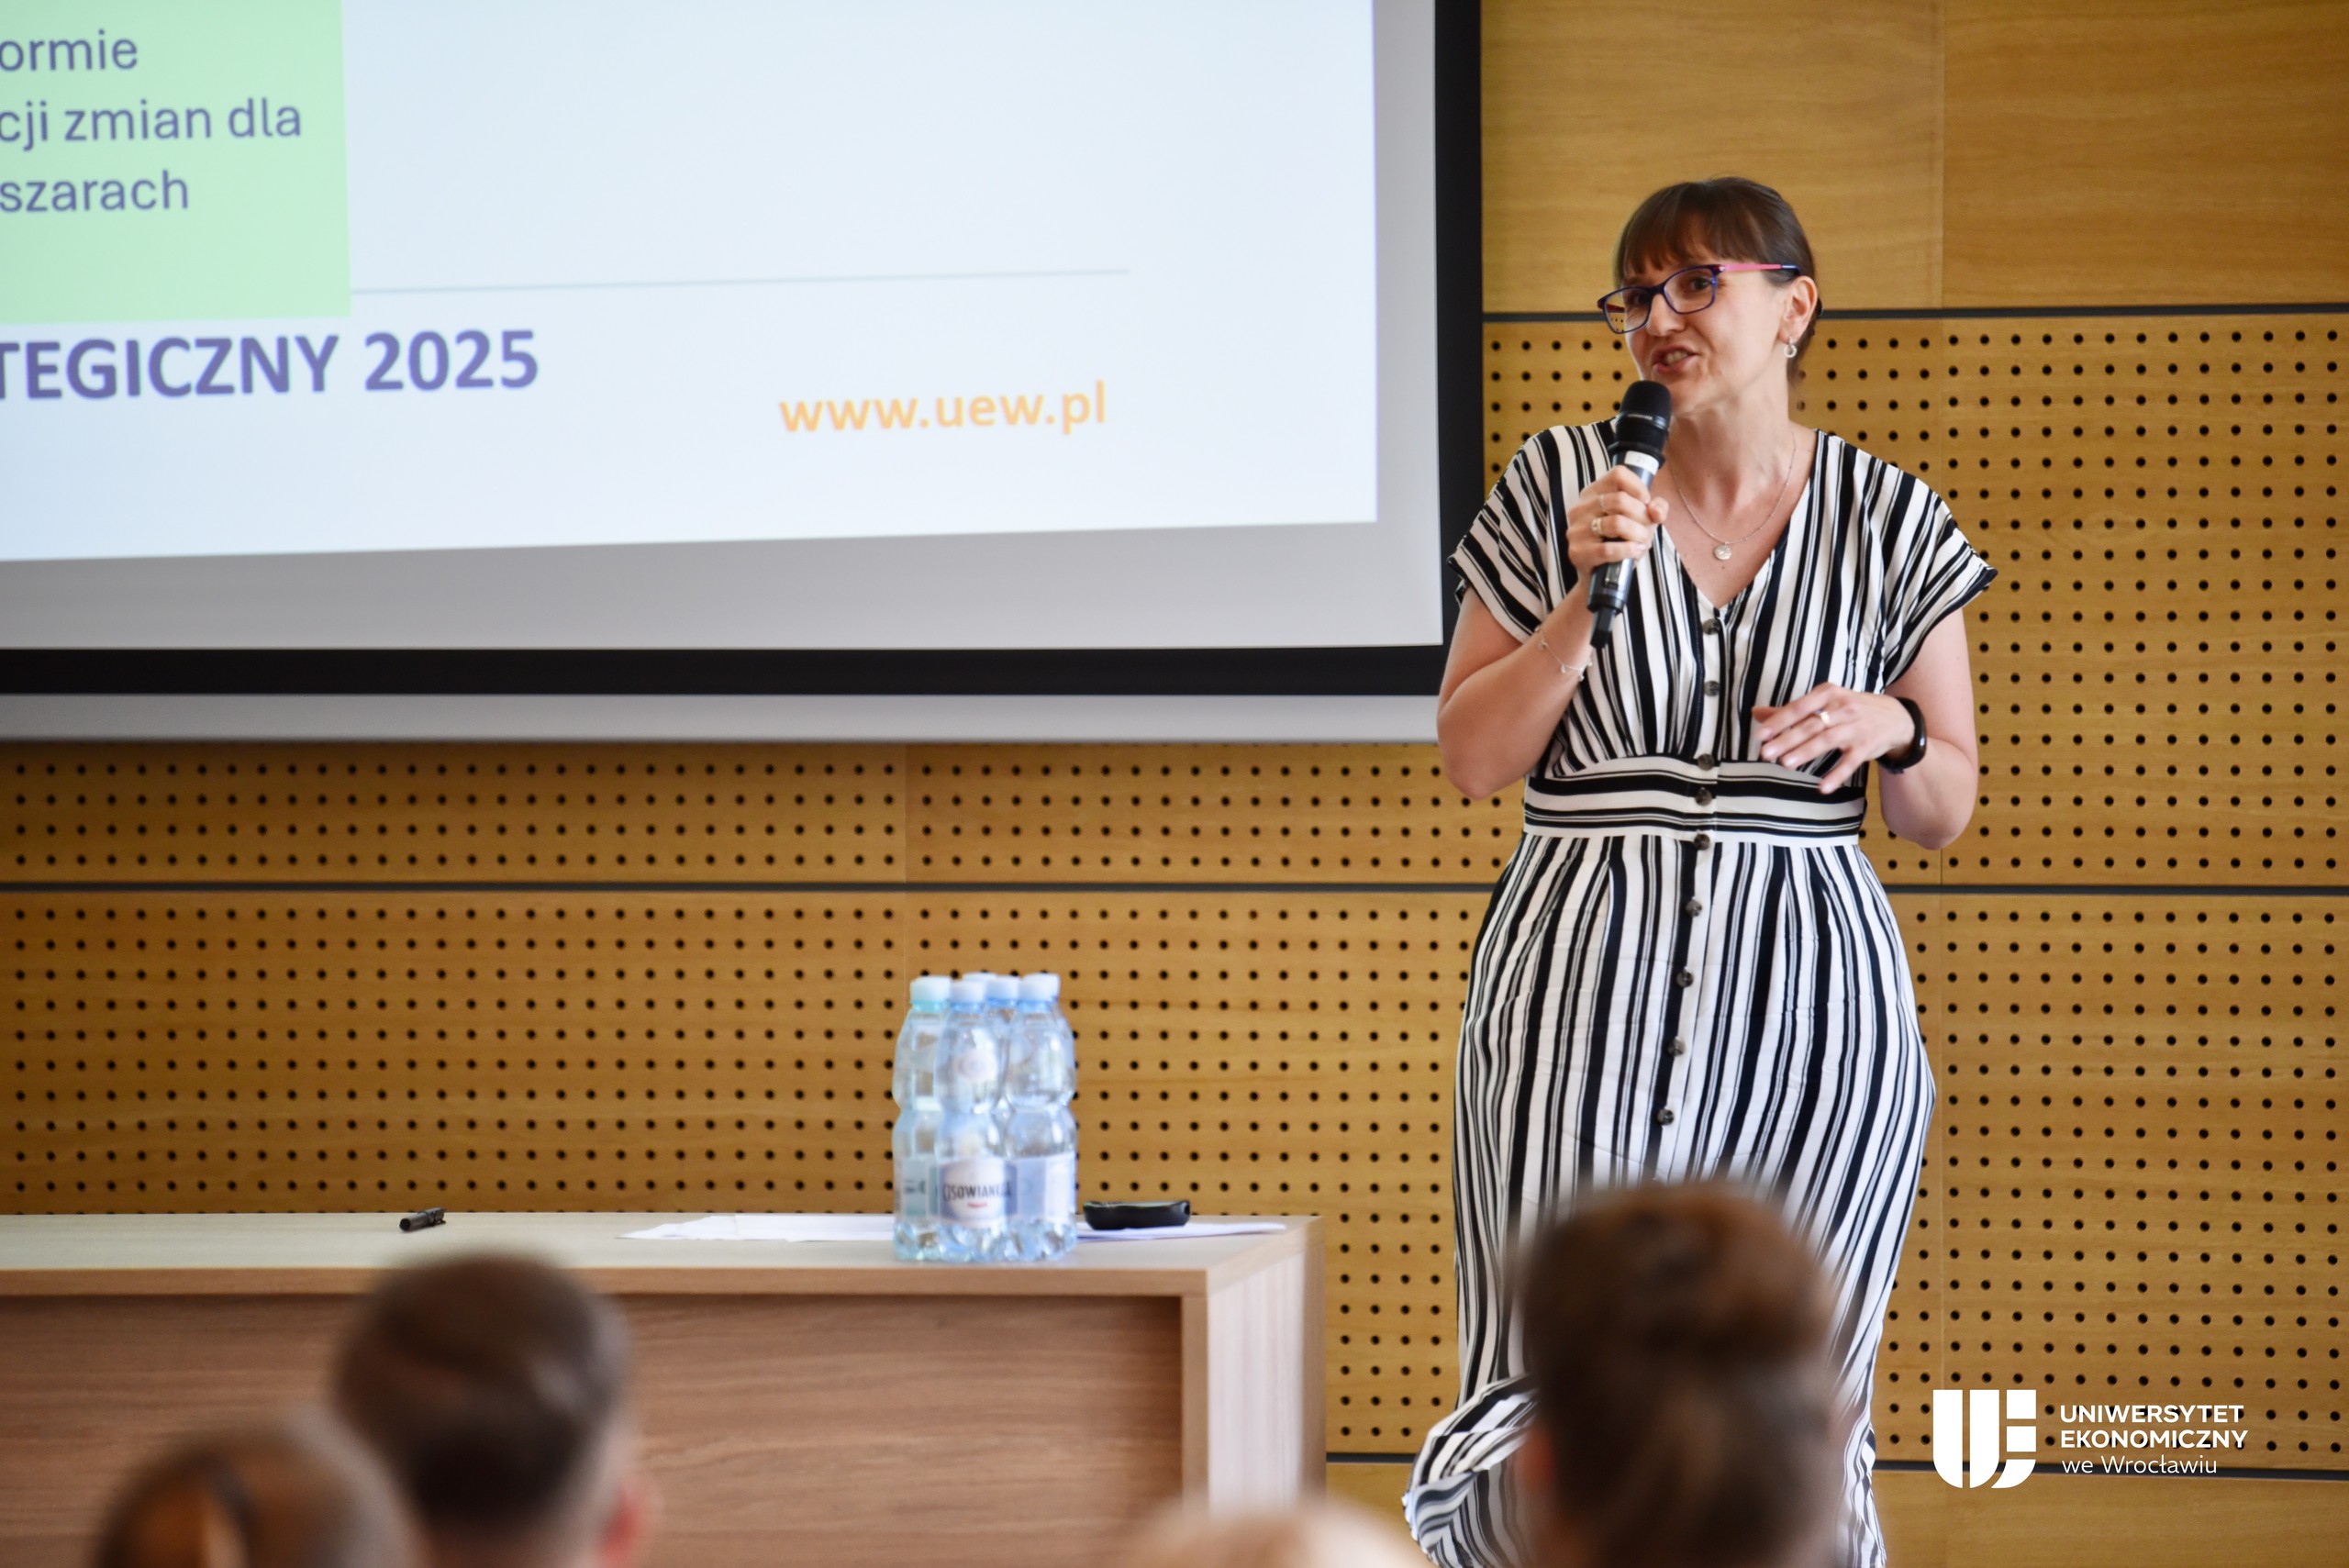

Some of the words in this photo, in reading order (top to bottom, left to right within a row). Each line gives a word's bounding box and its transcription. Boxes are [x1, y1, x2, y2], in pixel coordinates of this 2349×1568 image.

[0, 28, 139, 72] ormie
[0, 99, 49, 152] cji
[63, 97, 212, 141] zmian
[228, 96, 302, 139] dla
[0, 169, 189, 213] szarach
[363, 328, 539, 393] 2025
[779, 379, 1106, 436] www.uew.pl
